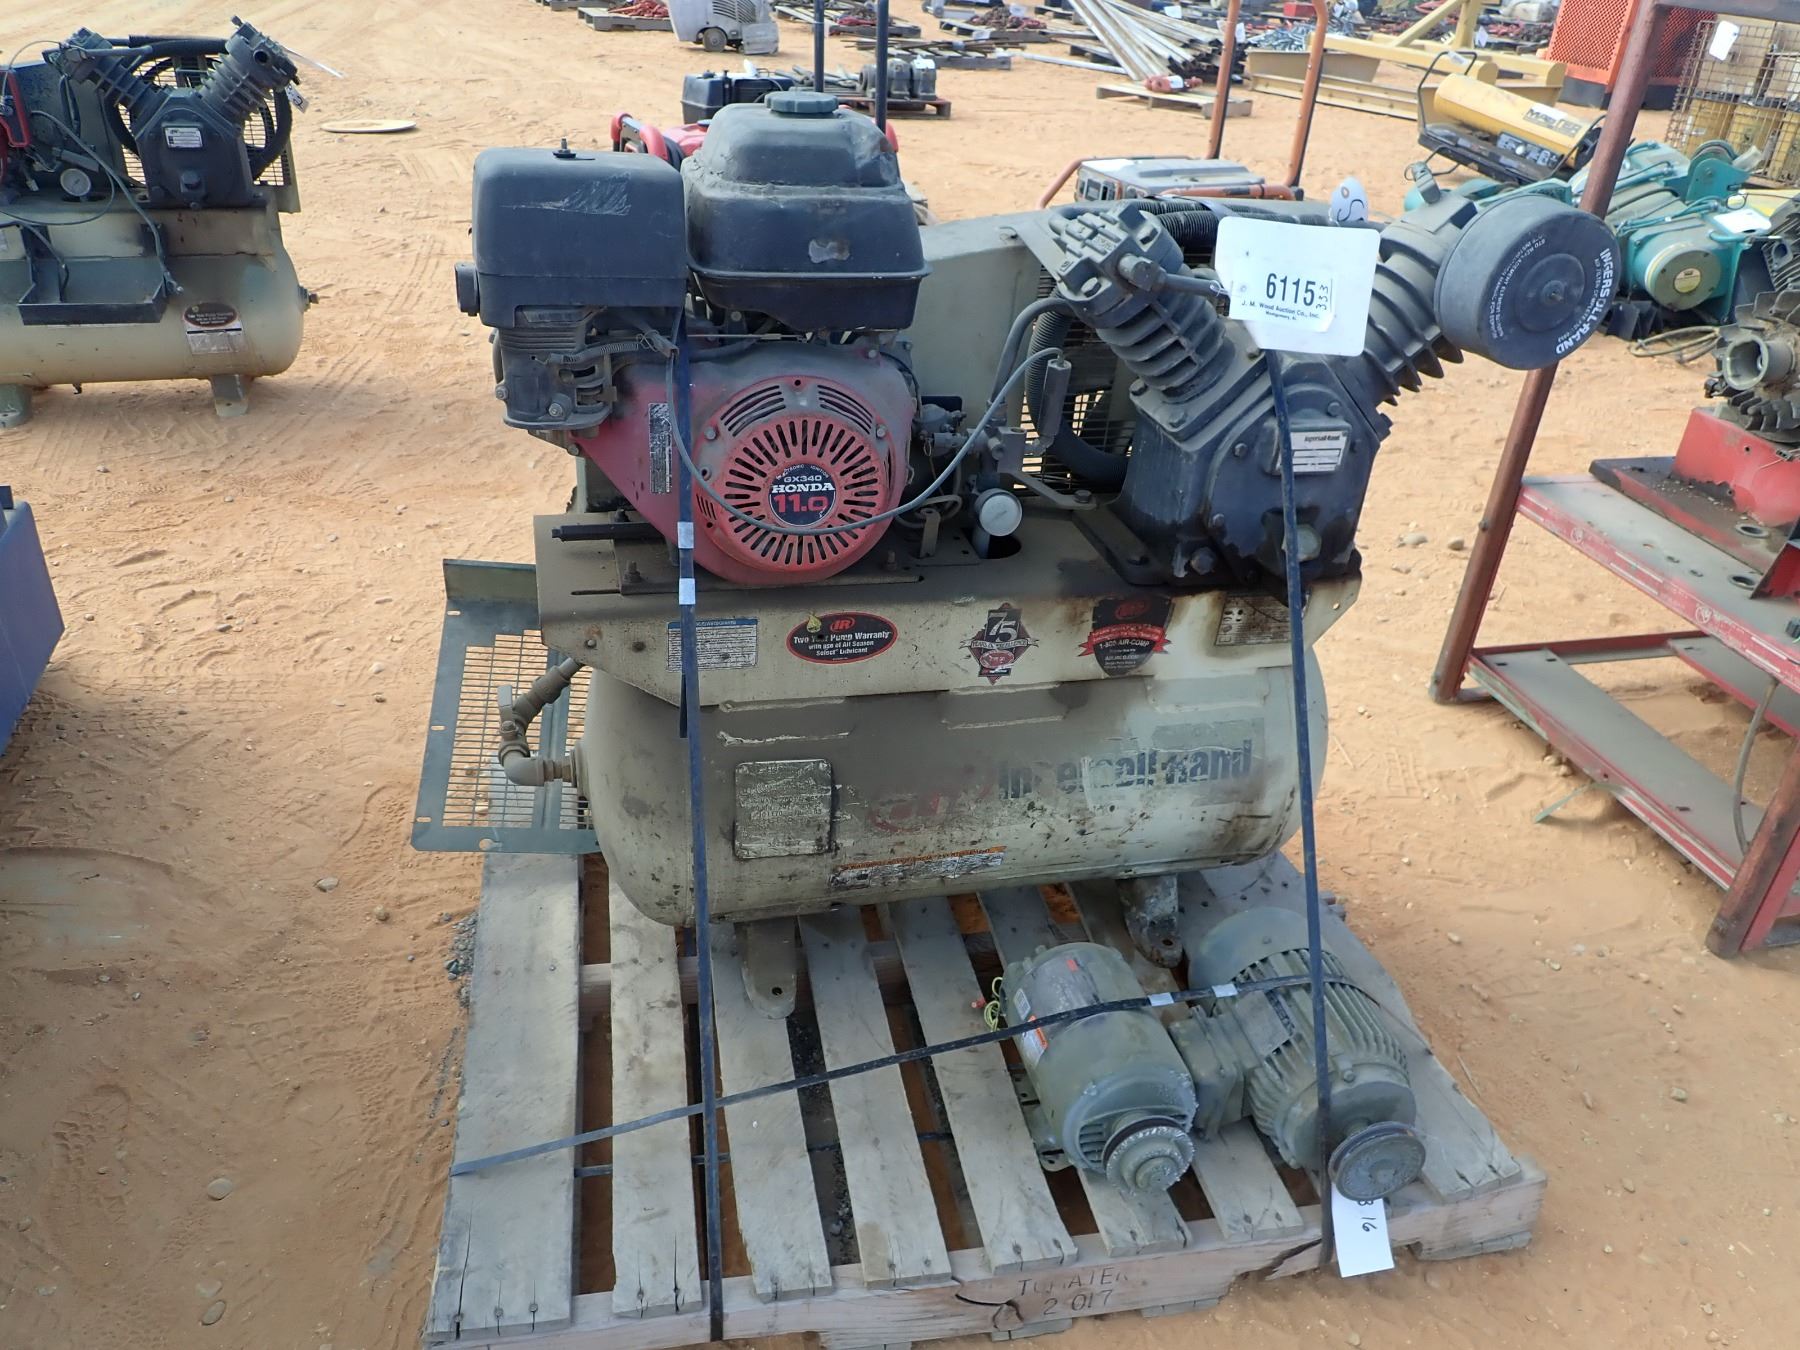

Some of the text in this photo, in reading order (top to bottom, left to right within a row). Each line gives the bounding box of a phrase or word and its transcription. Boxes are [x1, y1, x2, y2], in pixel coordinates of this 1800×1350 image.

[1266, 272, 1316, 307] 6115
[1259, 303, 1275, 311] Wood
[1275, 305, 1296, 315] Auction
[783, 475, 822, 483] GX340
[771, 482, 836, 494] HONDA
[773, 493, 829, 513] 11.0
[988, 612, 1017, 642] 75
[793, 636, 809, 644] Two
[830, 633, 853, 642] Pump
[854, 631, 890, 639] Warranty
[839, 647, 868, 655] Lubricant
